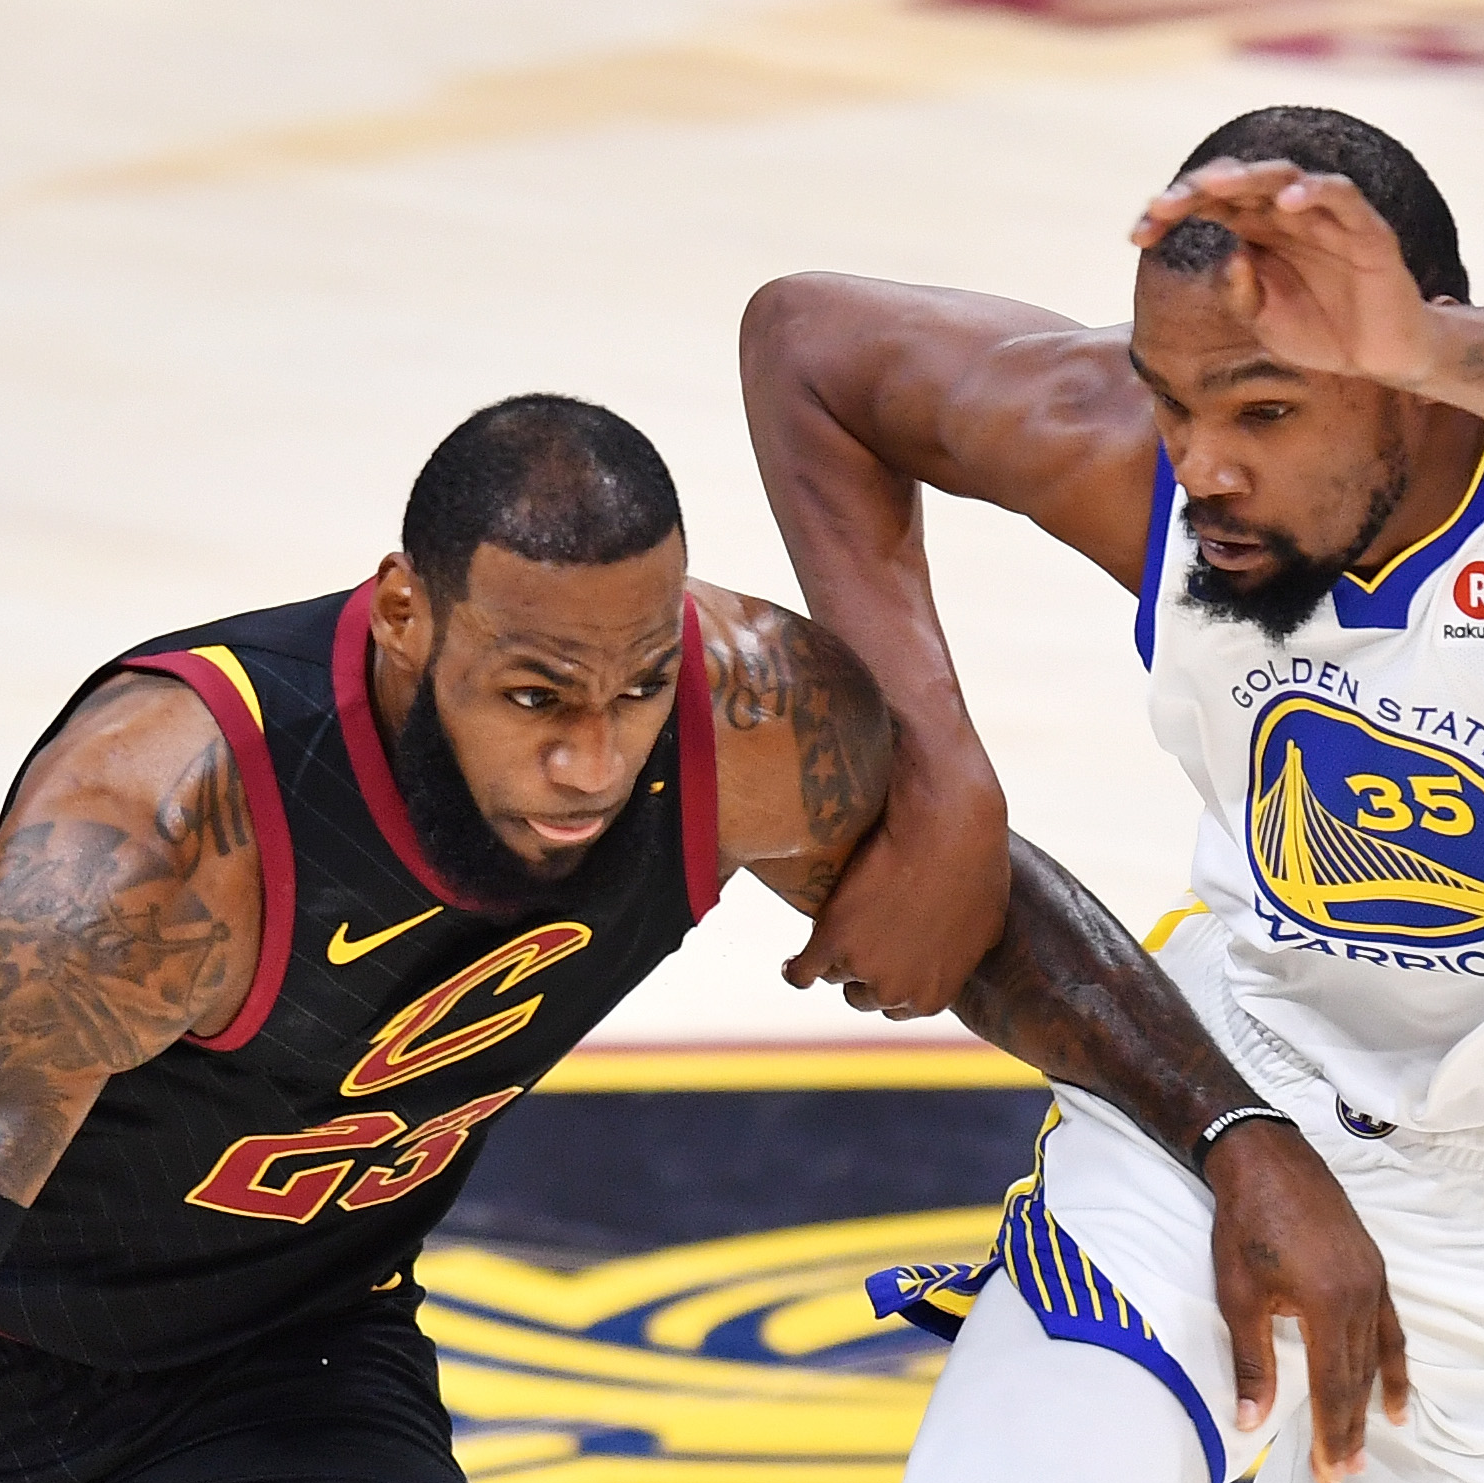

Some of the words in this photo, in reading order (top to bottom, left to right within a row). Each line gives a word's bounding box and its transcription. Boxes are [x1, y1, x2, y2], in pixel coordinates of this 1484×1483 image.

[1231, 657, 1359, 708] GOLDEN
[1344, 773, 1475, 836] 35
[184, 1086, 523, 1223] 23
